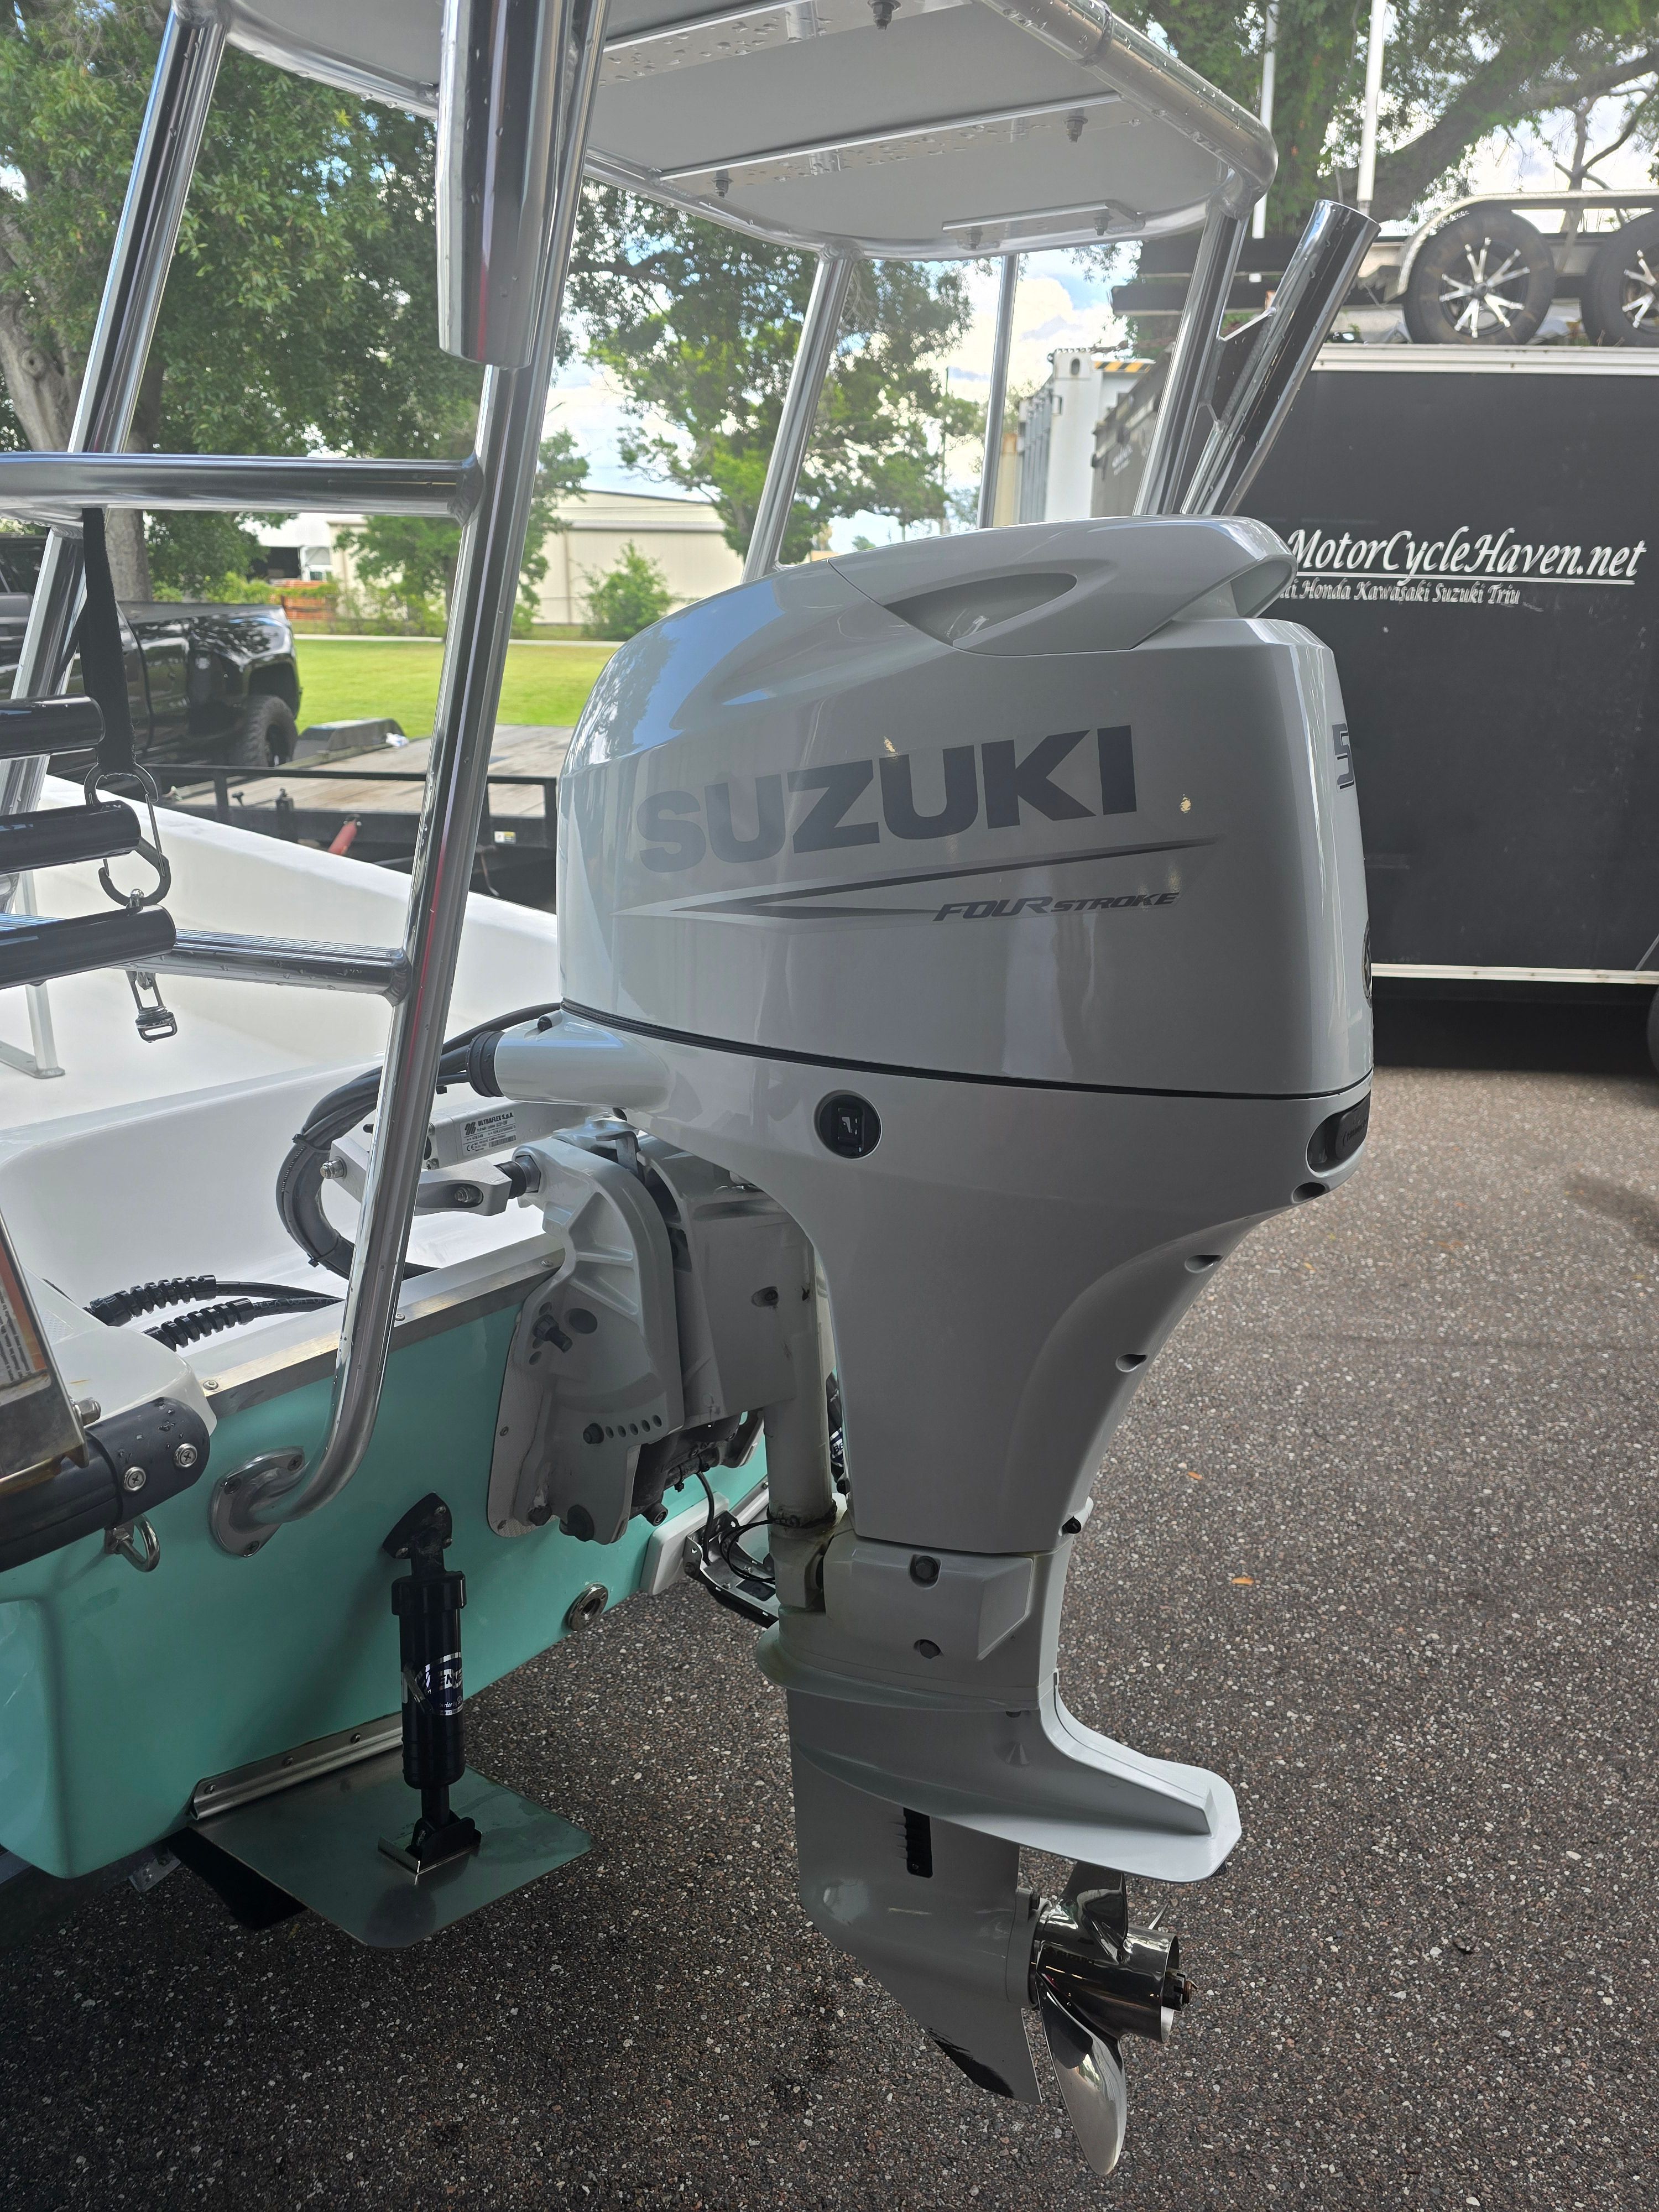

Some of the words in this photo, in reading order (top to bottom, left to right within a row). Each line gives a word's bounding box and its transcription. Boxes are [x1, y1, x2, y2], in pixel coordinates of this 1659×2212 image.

[1287, 526, 1647, 586] MotorCycleHaven.net
[1300, 577, 1351, 600] Honda
[1354, 580, 1432, 603] Kawasaki
[1432, 581, 1486, 603] Suzuki
[635, 725, 1138, 873] SUZUKI
[933, 896, 1053, 921] FOUR
[1051, 892, 1180, 912] STROKE
[477, 1115, 502, 1126] ULTRAFLEX
